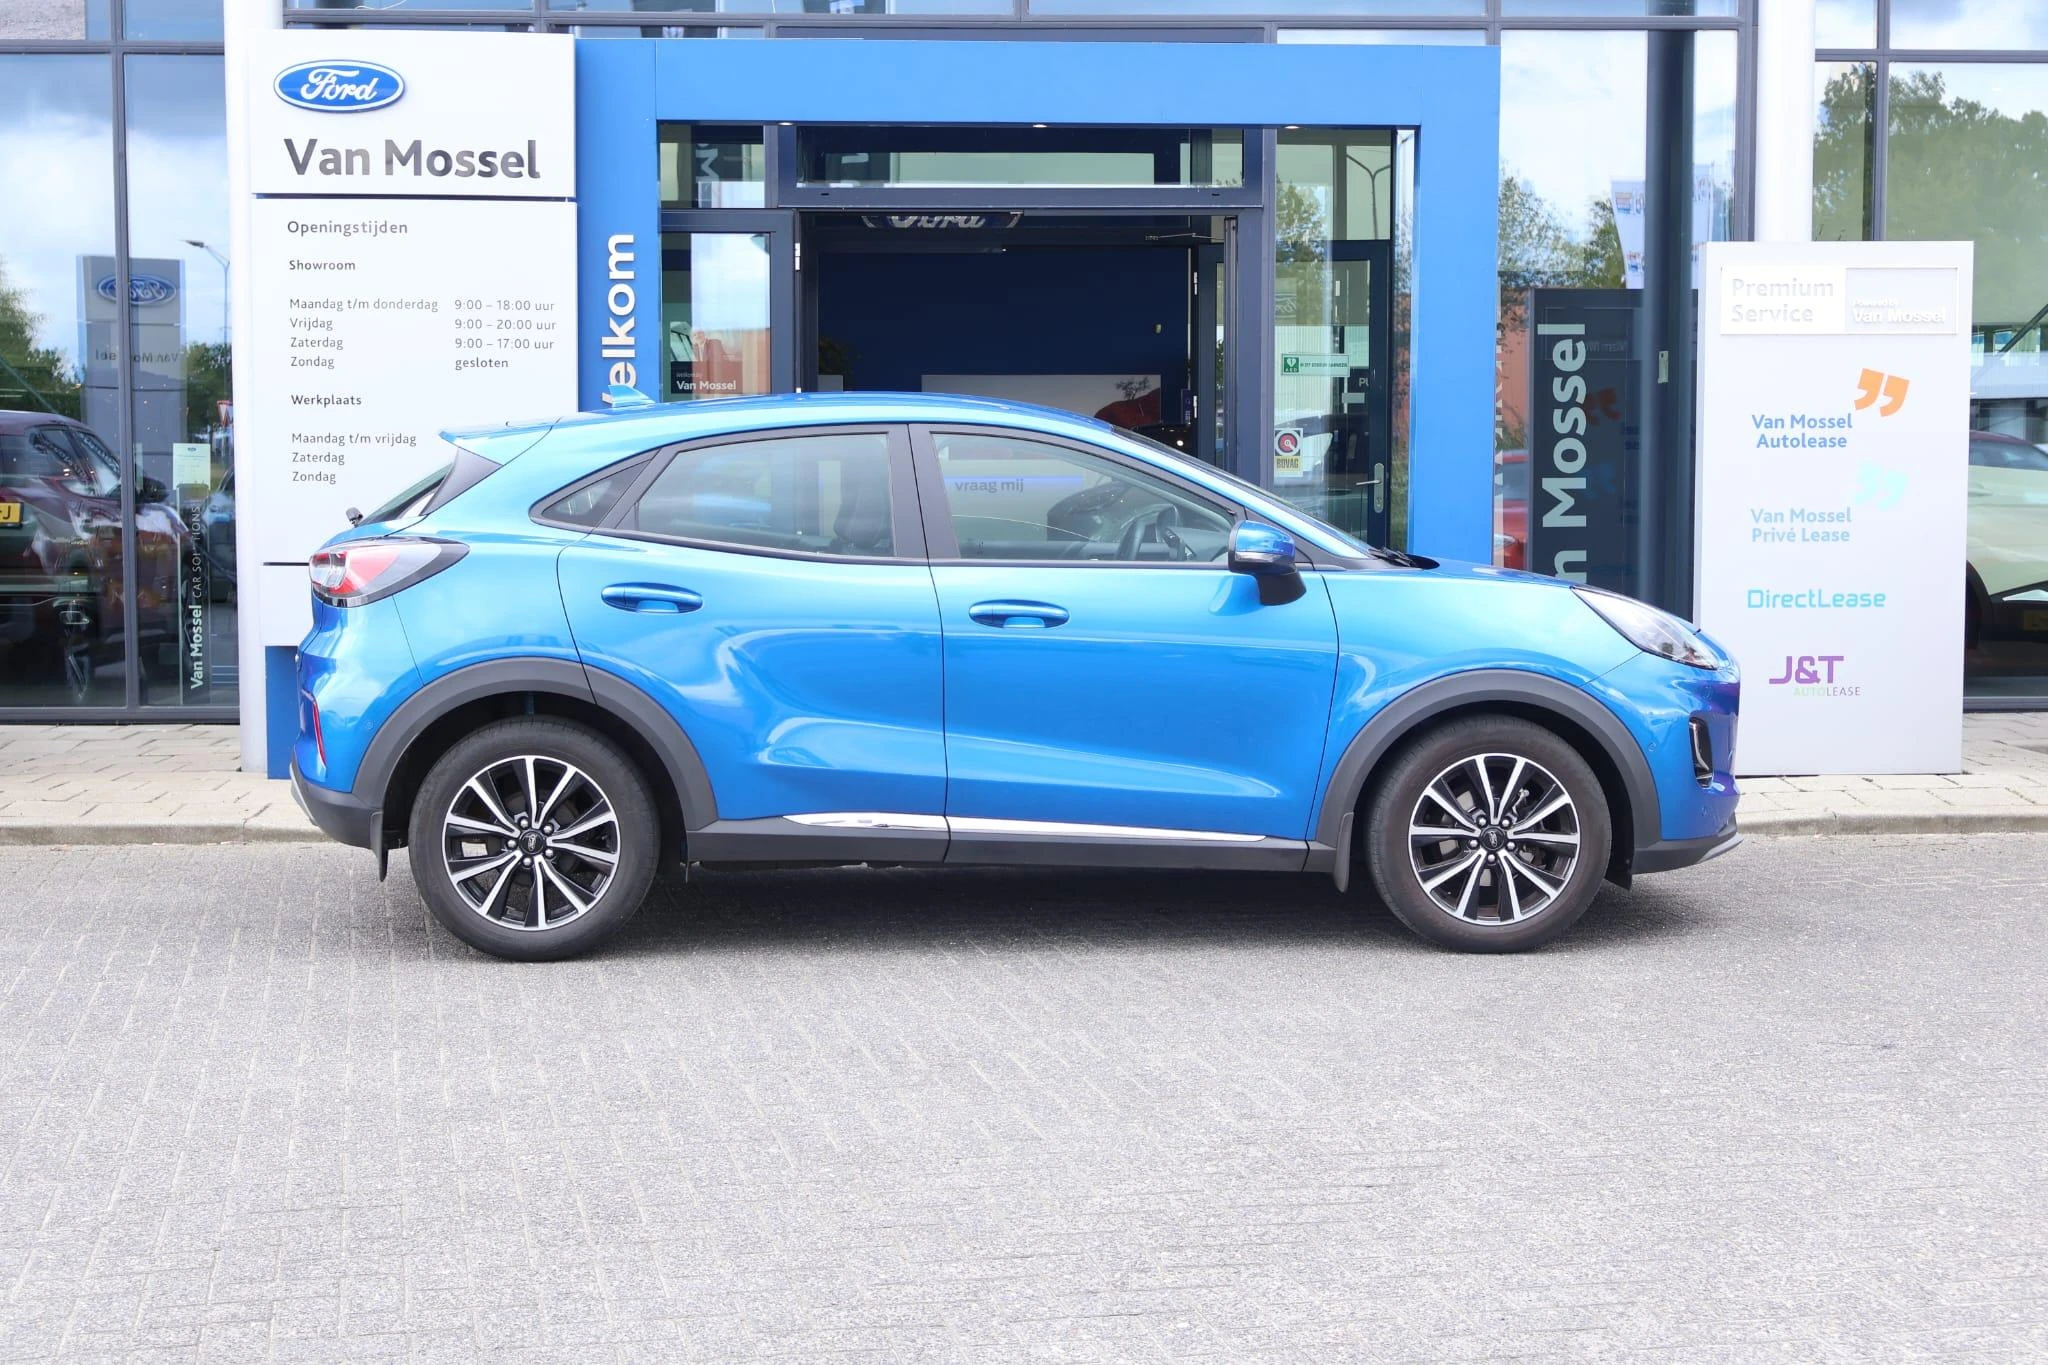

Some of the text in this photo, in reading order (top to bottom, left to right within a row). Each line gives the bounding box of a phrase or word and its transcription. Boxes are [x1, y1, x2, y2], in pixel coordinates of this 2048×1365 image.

[300, 68, 379, 101] Ford
[284, 138, 541, 179] Van Mossel
[287, 220, 408, 237] Openingstijden
[288, 259, 356, 271] Showroom
[1732, 277, 1834, 297] Premium
[289, 298, 438, 313] Maandag t/m donderdag
[455, 299, 483, 310] 9:00
[496, 299, 531, 311] 18:00
[535, 303, 555, 311] uur
[602, 234, 637, 405] elkom
[1731, 304, 1814, 323] Service
[1853, 308, 1945, 325] Van Mossel
[289, 317, 333, 331] Vrijdag
[454, 318, 483, 329] 9:00
[496, 319, 533, 330] 20:00
[536, 322, 557, 330] uur
[290, 336, 344, 351] Zaterdag
[455, 338, 483, 349] 9:00
[497, 338, 530, 349] 17:00
[534, 341, 555, 349] uur
[290, 355, 335, 370] Zondag
[455, 356, 509, 371] gesloten
[676, 380, 737, 390] Van Mossel
[291, 394, 362, 408] Werkplaats
[1537, 324, 1587, 528] Mossel
[1751, 413, 1853, 429] Van Mossel
[292, 432, 417, 447] Maandag t/m vrijdag
[1756, 433, 1848, 448] Autolease
[292, 451, 345, 466] Zaterdag
[292, 471, 336, 485] Zondag
[954, 475, 1024, 494] vraag mij
[1750, 506, 1852, 523] Van Mossel
[1751, 527, 1851, 543] Privé Lease
[192, 576, 202, 598] CAR
[1747, 589, 1886, 608] DirectLease
[188, 604, 203, 657] Mossel
[190, 661, 204, 690] Van
[1769, 655, 1844, 685] J&T
[1794, 686, 1861, 697] AUTOLEASE
